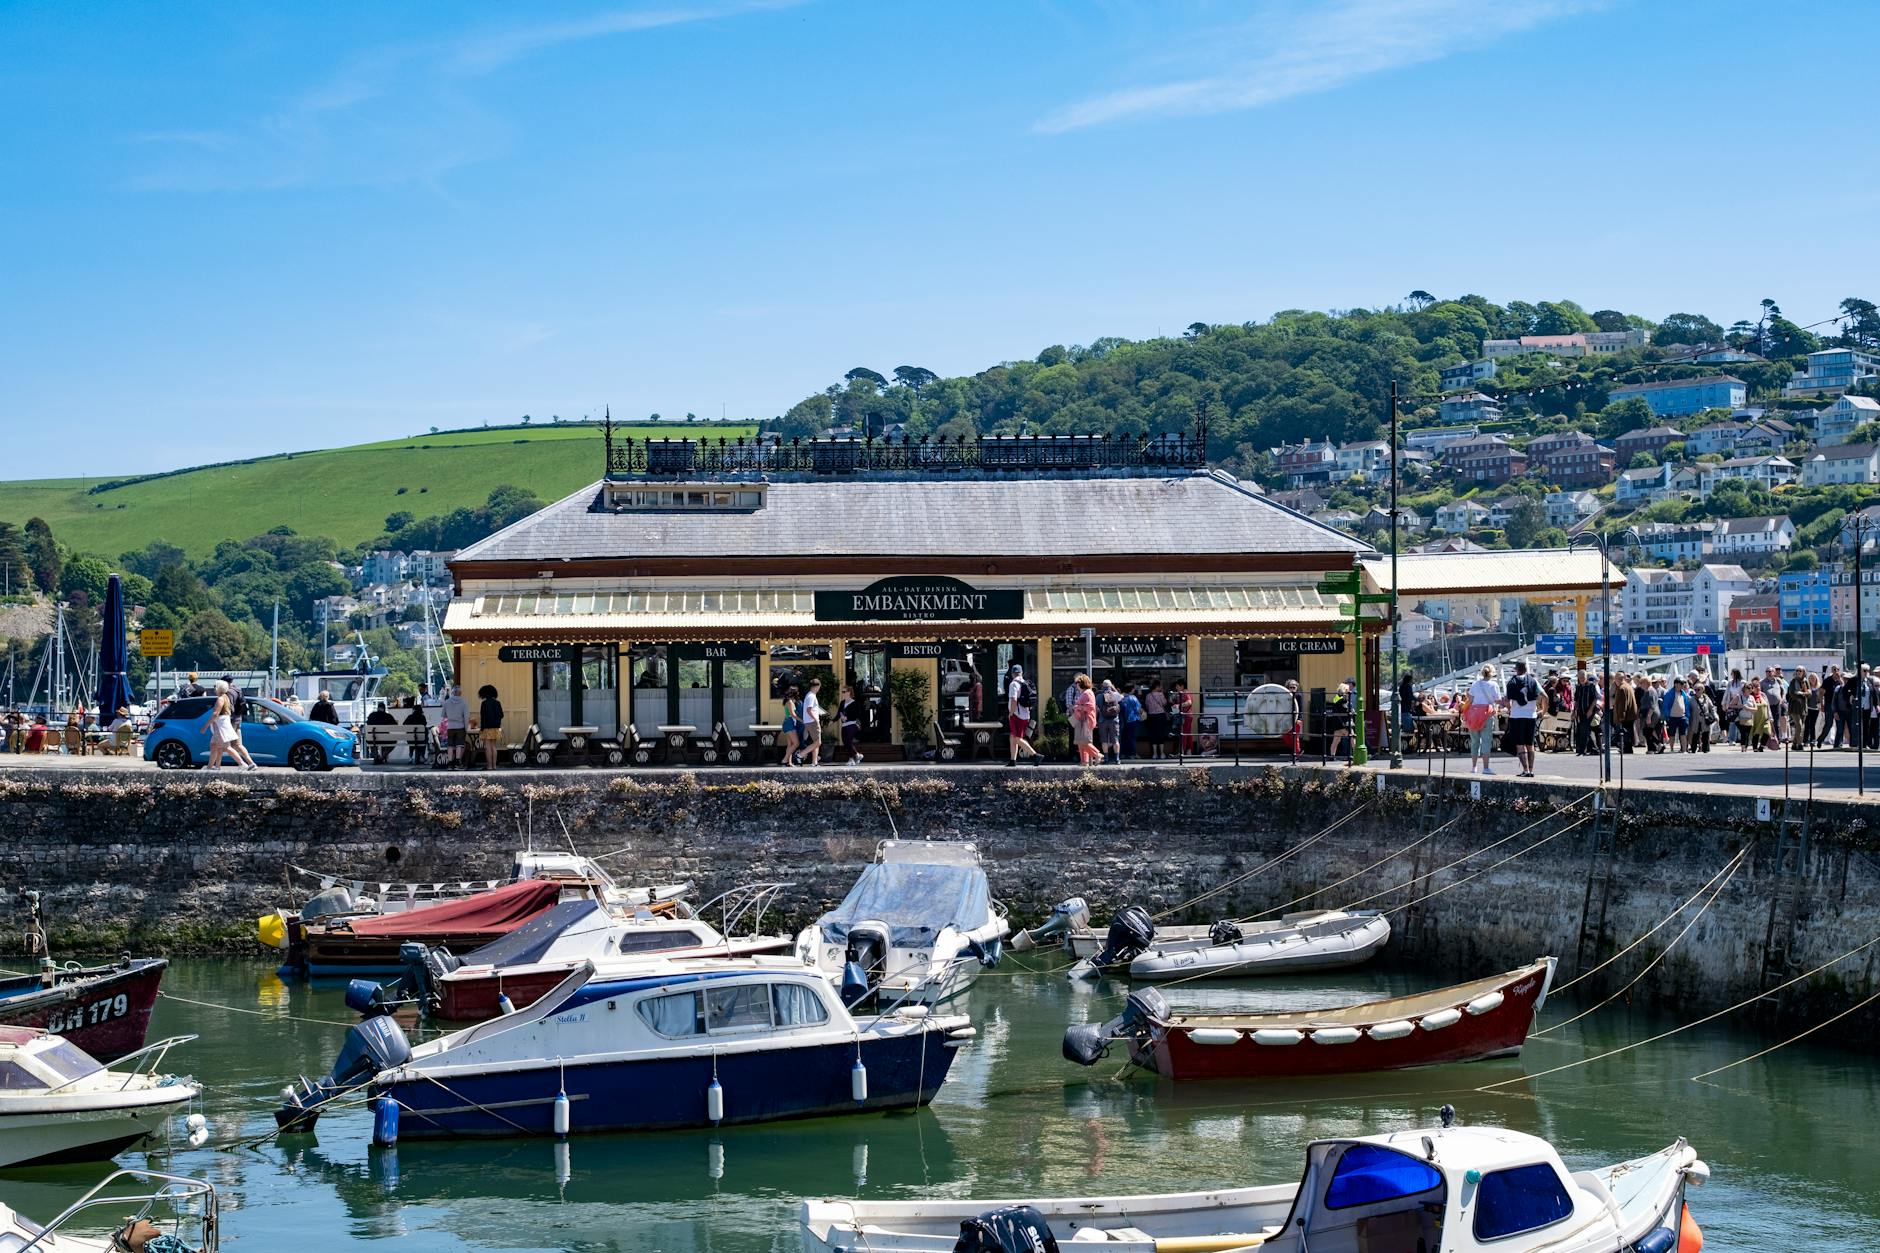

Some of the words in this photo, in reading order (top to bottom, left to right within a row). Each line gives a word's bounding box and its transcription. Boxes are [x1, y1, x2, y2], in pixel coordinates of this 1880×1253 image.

[852, 594, 987, 611] EMBANKMENT
[903, 645, 942, 655] BISTRO
[1099, 644, 1158, 654] TAKEAWAY
[1279, 642, 1297, 651] ICE
[1300, 642, 1337, 651] CREAM
[512, 649, 562, 659] TERRACE
[706, 648, 727, 657] BAR
[1473, 784, 1479, 796] 2
[1760, 804, 1766, 816] 4
[88, 993, 128, 1024] 179
[557, 1014, 577, 1023] Stella
[375, 1017, 392, 1038] YAMAHA
